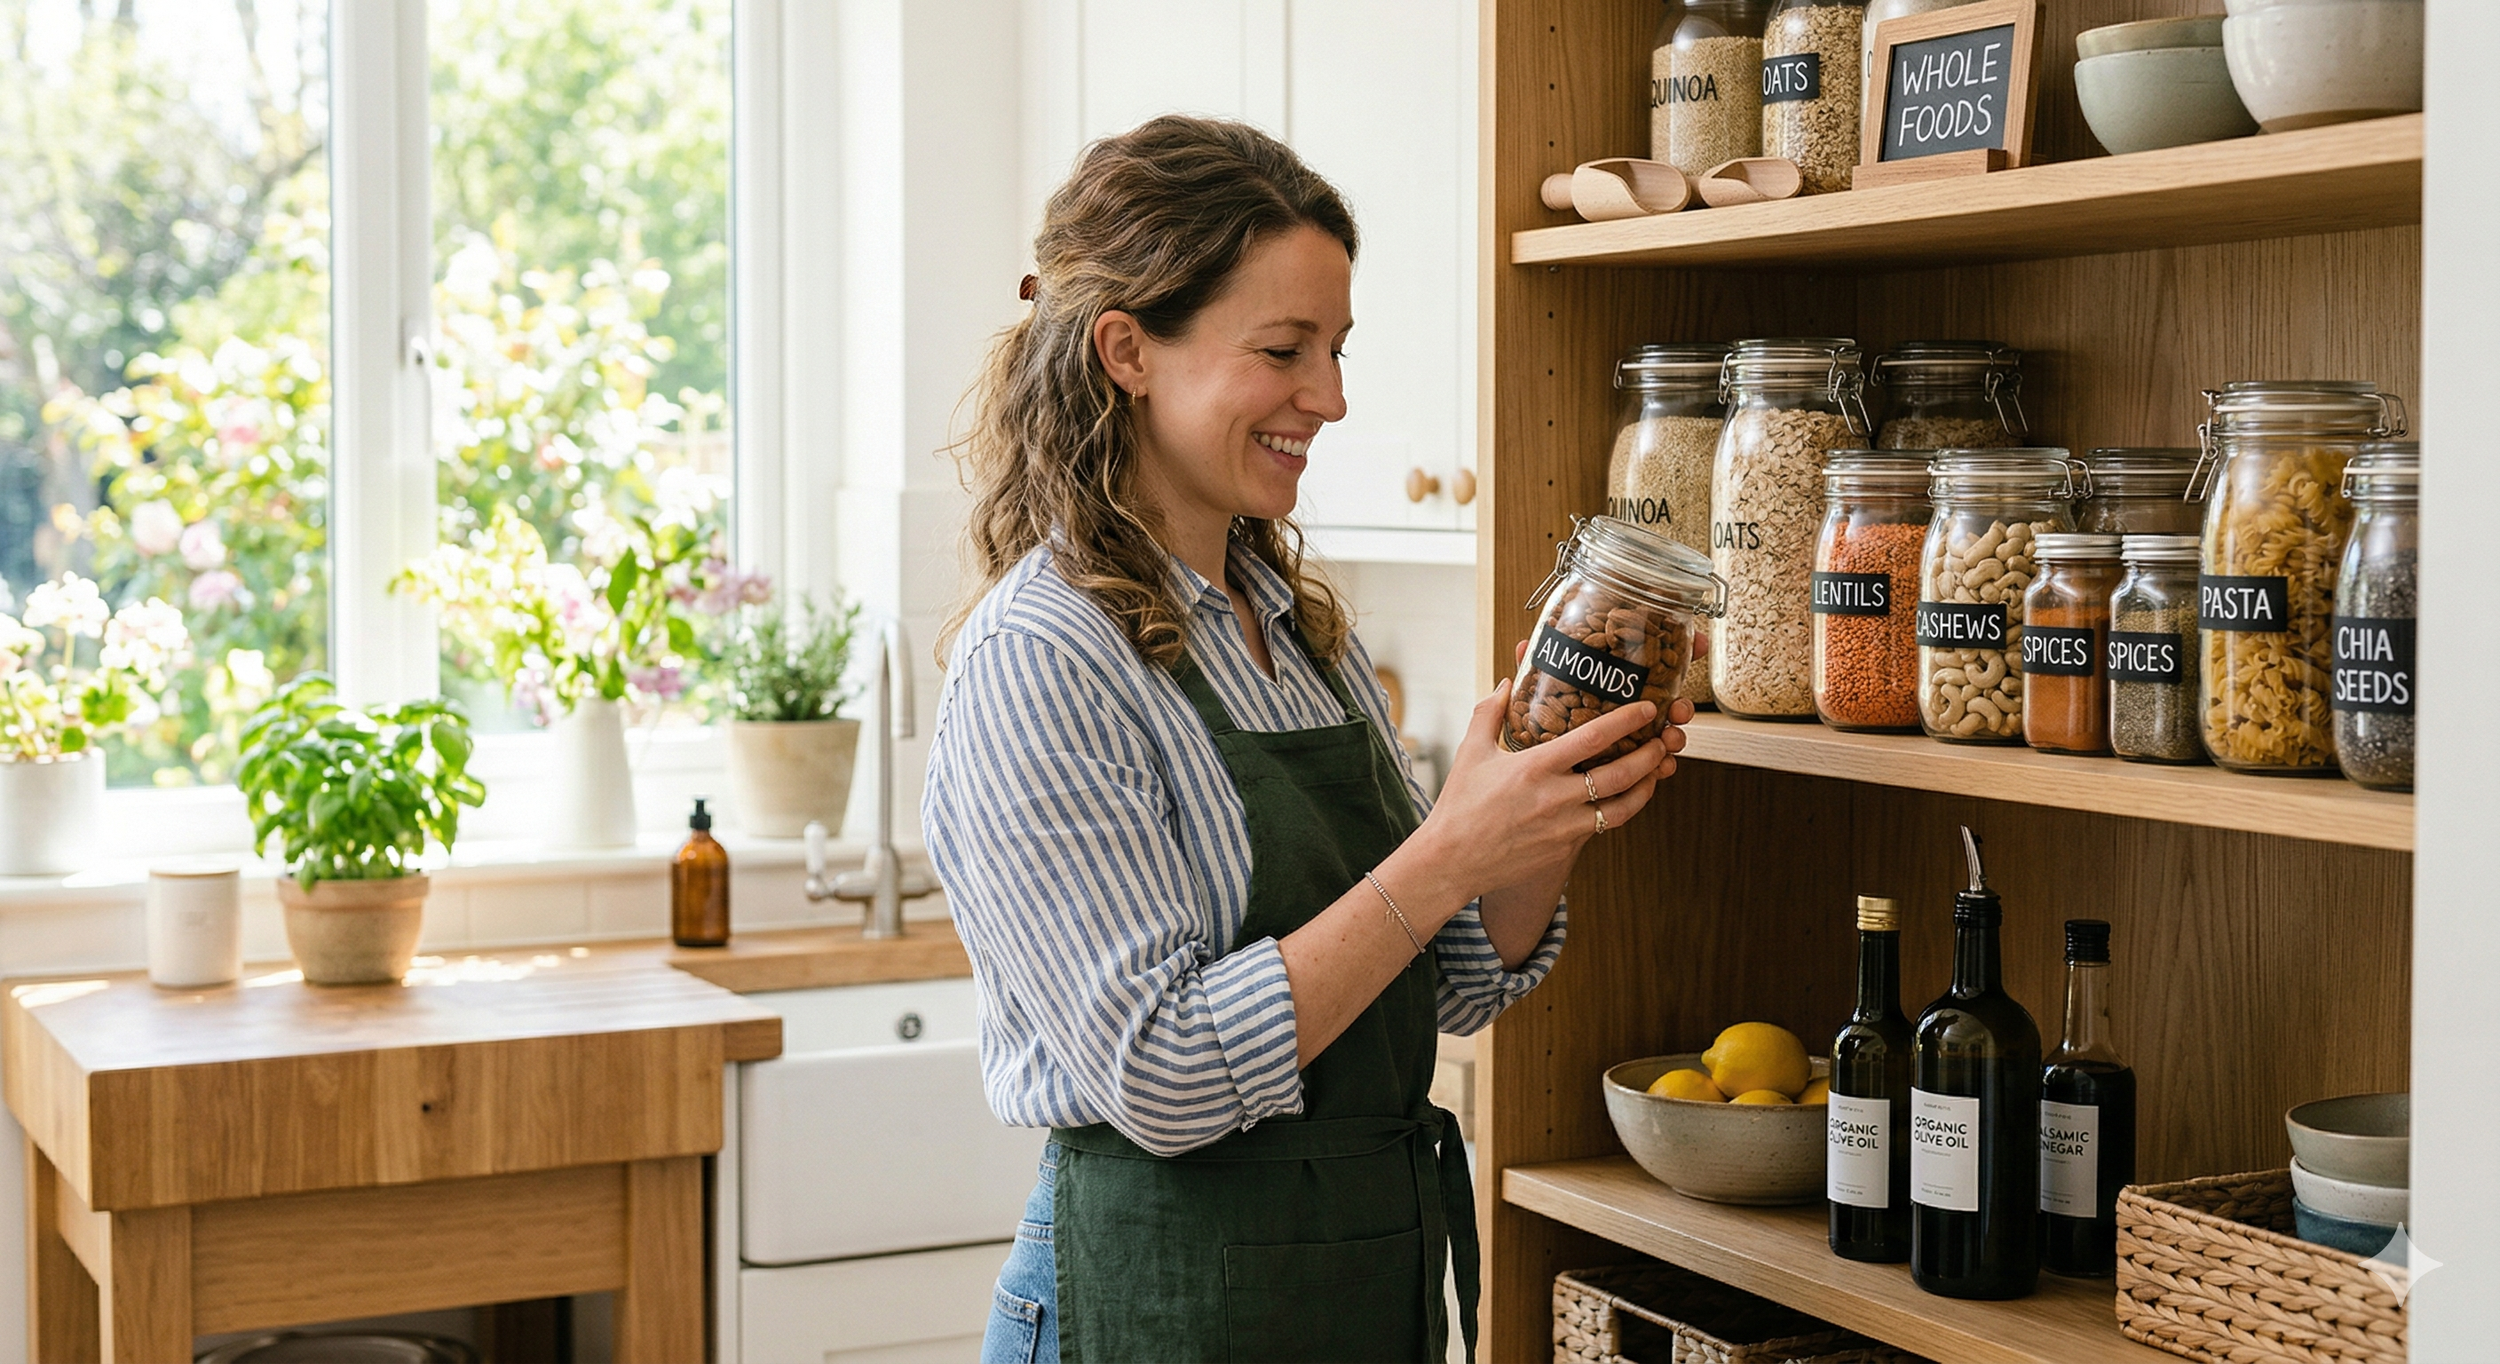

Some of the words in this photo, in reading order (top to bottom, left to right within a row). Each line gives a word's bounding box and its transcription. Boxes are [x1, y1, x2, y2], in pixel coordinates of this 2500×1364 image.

[1763, 61, 1808, 96] OATS
[1903, 43, 2001, 95] WHOLE
[1898, 93, 1992, 147] FOODS
[1714, 522, 1760, 550] OATS
[1814, 580, 1885, 607] LENTILS
[2202, 586, 2273, 621] PASTA
[1916, 610, 2000, 640] CASHEWS
[2023, 636, 2087, 666] SPICES
[2108, 641, 2175, 673] SPICES
[2337, 625, 2394, 662] CHIA
[1537, 637, 1639, 698] ALMONDS
[2336, 668, 2410, 705] SEEDS
[1914, 1129, 1944, 1147] OLIVE
[1945, 1136, 1969, 1149] OIL
[1915, 1116, 1968, 1135] ORGANIC
[1856, 1137, 1880, 1149] OIL
